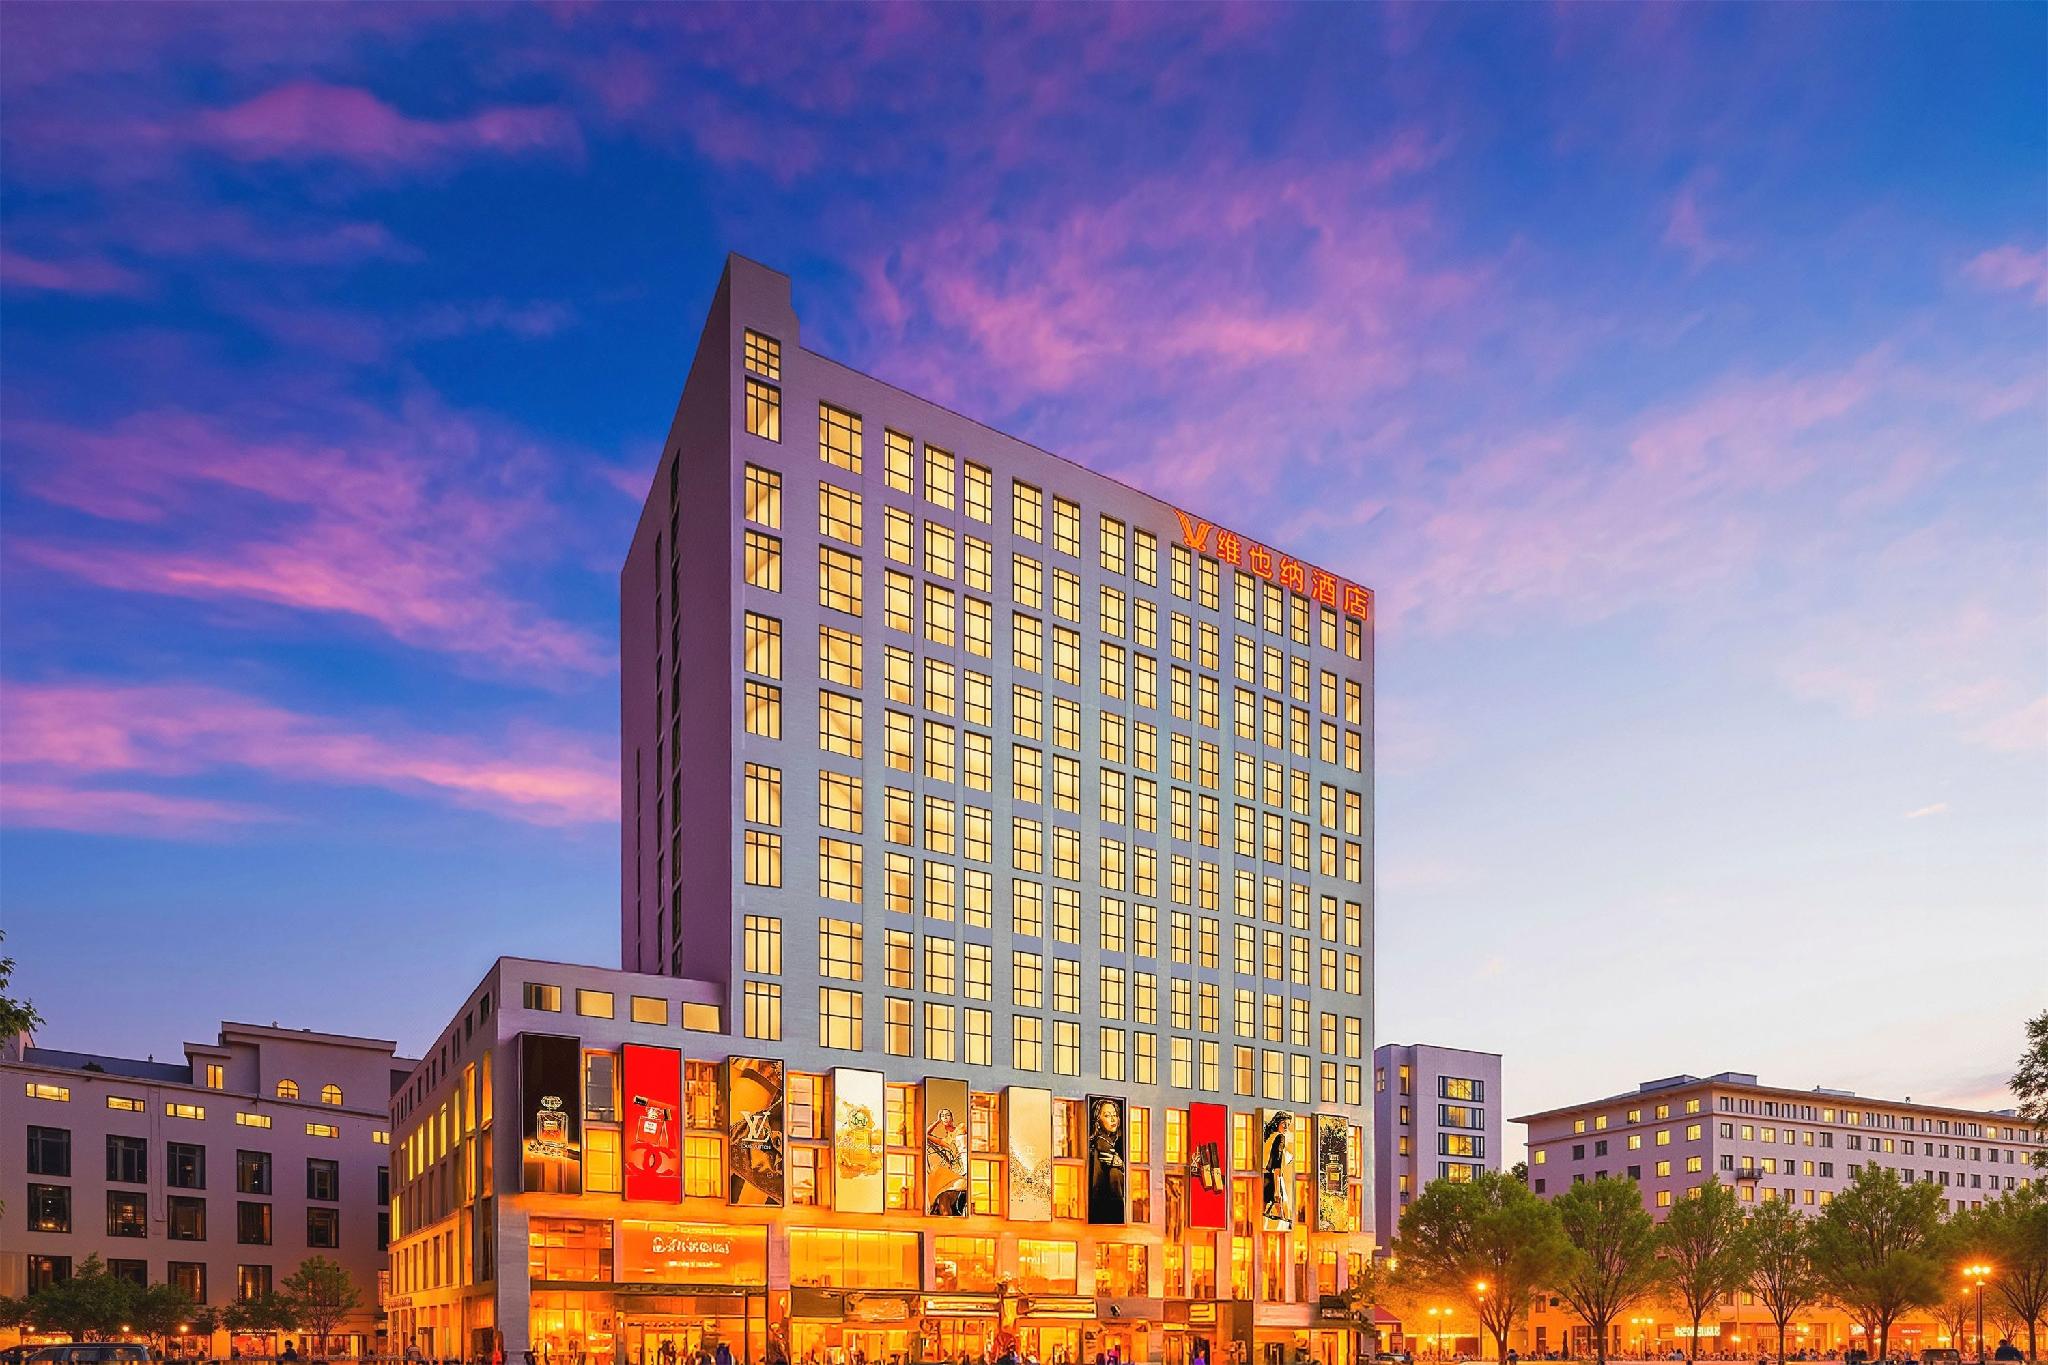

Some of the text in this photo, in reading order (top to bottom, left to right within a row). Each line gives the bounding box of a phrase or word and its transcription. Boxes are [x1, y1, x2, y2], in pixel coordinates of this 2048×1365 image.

[1216, 528, 1369, 621] 维也纳酒店
